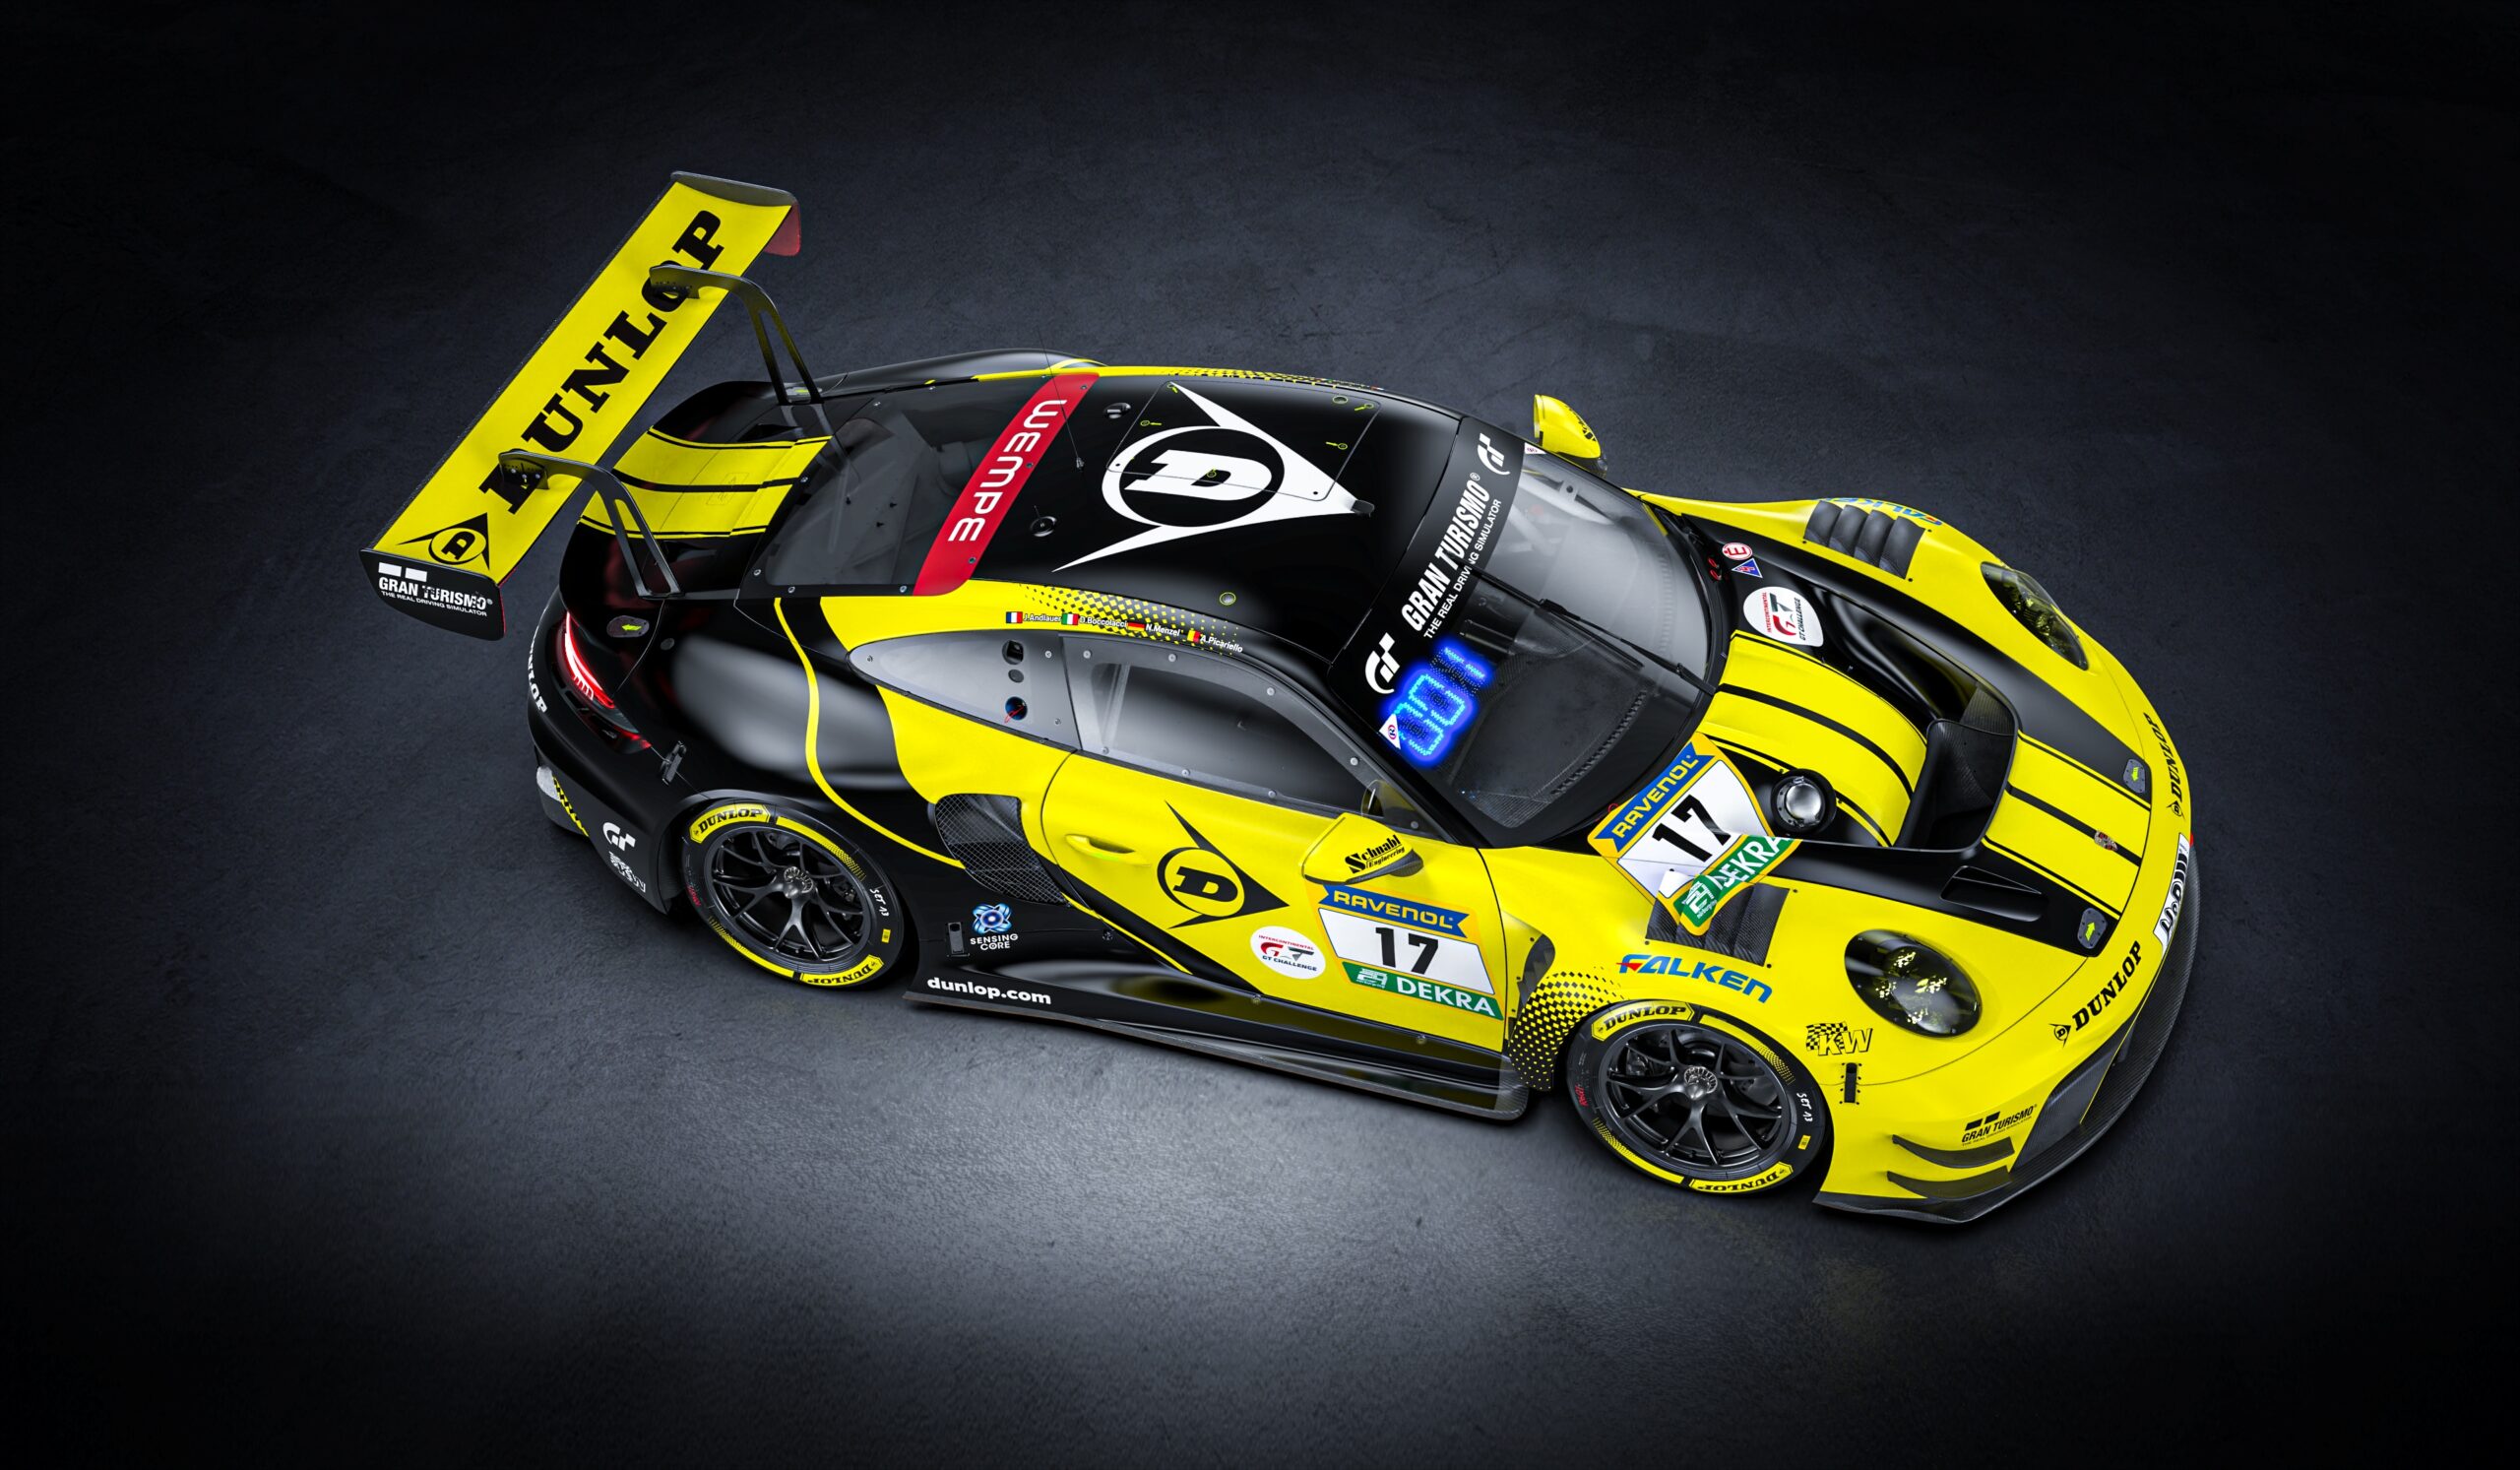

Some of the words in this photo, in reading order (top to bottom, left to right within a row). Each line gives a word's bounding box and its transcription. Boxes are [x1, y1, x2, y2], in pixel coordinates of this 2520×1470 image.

[948, 400, 1068, 542] WEMPE
[1423, 617, 1441, 639] THE
[1437, 593, 1458, 619] REAL
[1475, 498, 1502, 552] SIMULATOR
[379, 577, 418, 597] GRAN
[1401, 562, 1451, 632] GRAN
[381, 590, 396, 599] THE
[397, 594, 415, 603] REAL
[415, 598, 446, 608] DRIVING
[446, 604, 488, 617] SIMULATOR
[1145, 623, 1181, 637] N.Menzel
[1200, 635, 1243, 653] A.Picariello
[2143, 712, 2183, 802] DUNLOP
[698, 808, 763, 833] DUNLOP
[1652, 795, 1732, 863] 17
[1345, 835, 1402, 873] Schnabl
[1366, 847, 1406, 868] Engineering
[970, 933, 1019, 945] SENSING
[979, 941, 1011, 951] CORE
[1375, 927, 1439, 975] 17
[1273, 958, 1318, 972] CHALLENGE
[1615, 953, 1773, 1003] FALKEN
[927, 976, 1051, 1004] dunlop.com
[1396, 976, 1496, 1017] DEKRA
[2072, 940, 2142, 1032] DUNLOP
[1604, 1005, 1686, 1031] DUNLOP
[1818, 1027, 1874, 1056] KW
[1961, 1125, 1991, 1143] GRAN
